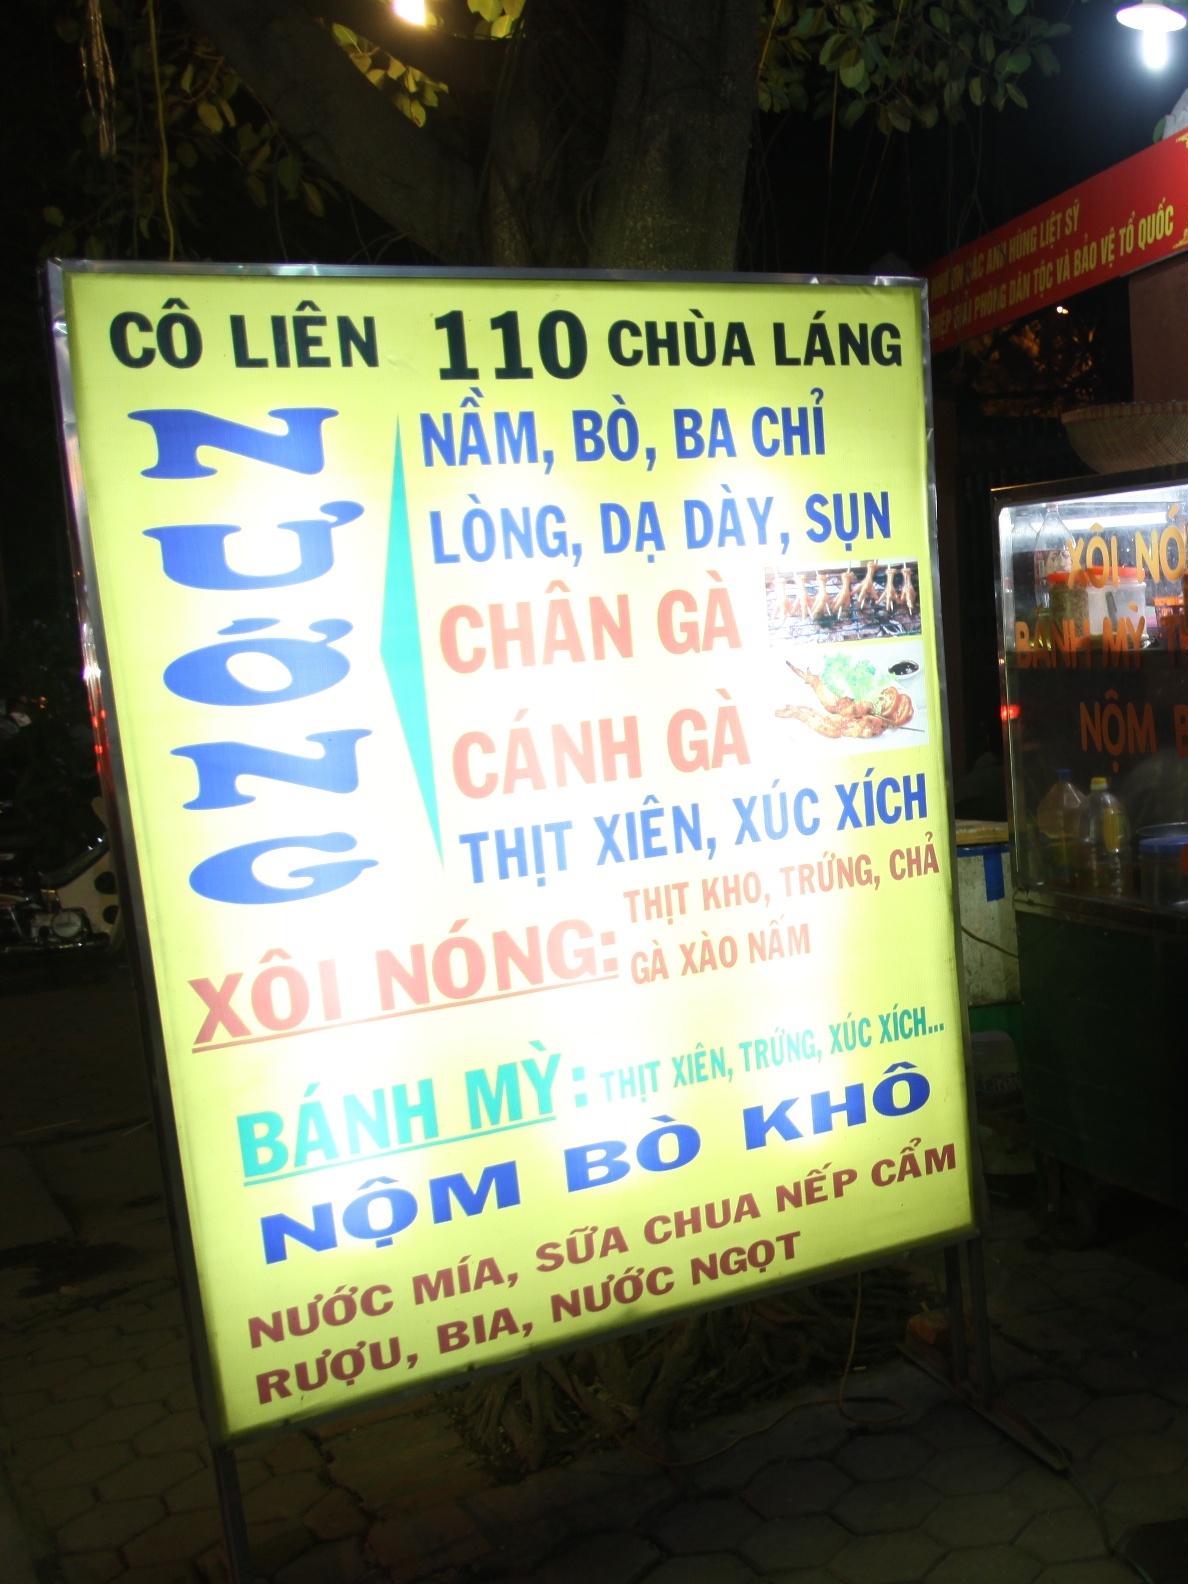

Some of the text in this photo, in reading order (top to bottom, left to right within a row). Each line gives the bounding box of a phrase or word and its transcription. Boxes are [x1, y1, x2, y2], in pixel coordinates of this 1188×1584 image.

[1009, 228, 1037, 263] HÙNG
[1040, 210, 1062, 249] LIỆT
[1009, 270, 1030, 306] DÂN
[1033, 259, 1053, 298] TỘC
[1056, 249, 1071, 284] VÀ
[1074, 232, 1097, 277] BẢO
[1100, 226, 1116, 267] VỆ
[1119, 210, 1135, 256] TỔ
[1137, 197, 1174, 247] QUỐC
[110, 298, 903, 380] CÔ LIÊN 110 CHÙA LÁNG
[419, 387, 826, 474] NẦM, BÒ, BA CHỈ
[429, 486, 892, 568] LÒNG, DẠ DÀY, SỤN
[1066, 522, 1119, 589] XÔI
[439, 570, 742, 674] CHÂN GÀ
[1102, 602, 1145, 668] MỲ
[452, 700, 752, 800] CÁNH GÀ
[1080, 689, 1158, 774] NỘM
[459, 766, 928, 889] THỊT XIÊN, XÚC XÍCH
[623, 831, 940, 927] THỊT KHO, TRỨNG, CHẢ
[187, 917, 619, 1044] XÔI NÓNG:
[630, 913, 811, 985] GÀ XÀO NẤM
[599, 1056, 661, 1103] THỊT
[670, 1044, 733, 1086] XIÊN,
[739, 1024, 824, 1074] TRỨNG,
[829, 1016, 873, 1054] XÚC
[236, 1082, 440, 1180] BÁNH
[260, 1061, 932, 1265] NỘM BÒ KHÔ
[248, 1137, 958, 1349] NƯỚC MÍA, SỮA CHUA NẾP CẨM
[256, 1232, 801, 1405] RƯỢU, BIA, NƯỚC NGỌT
